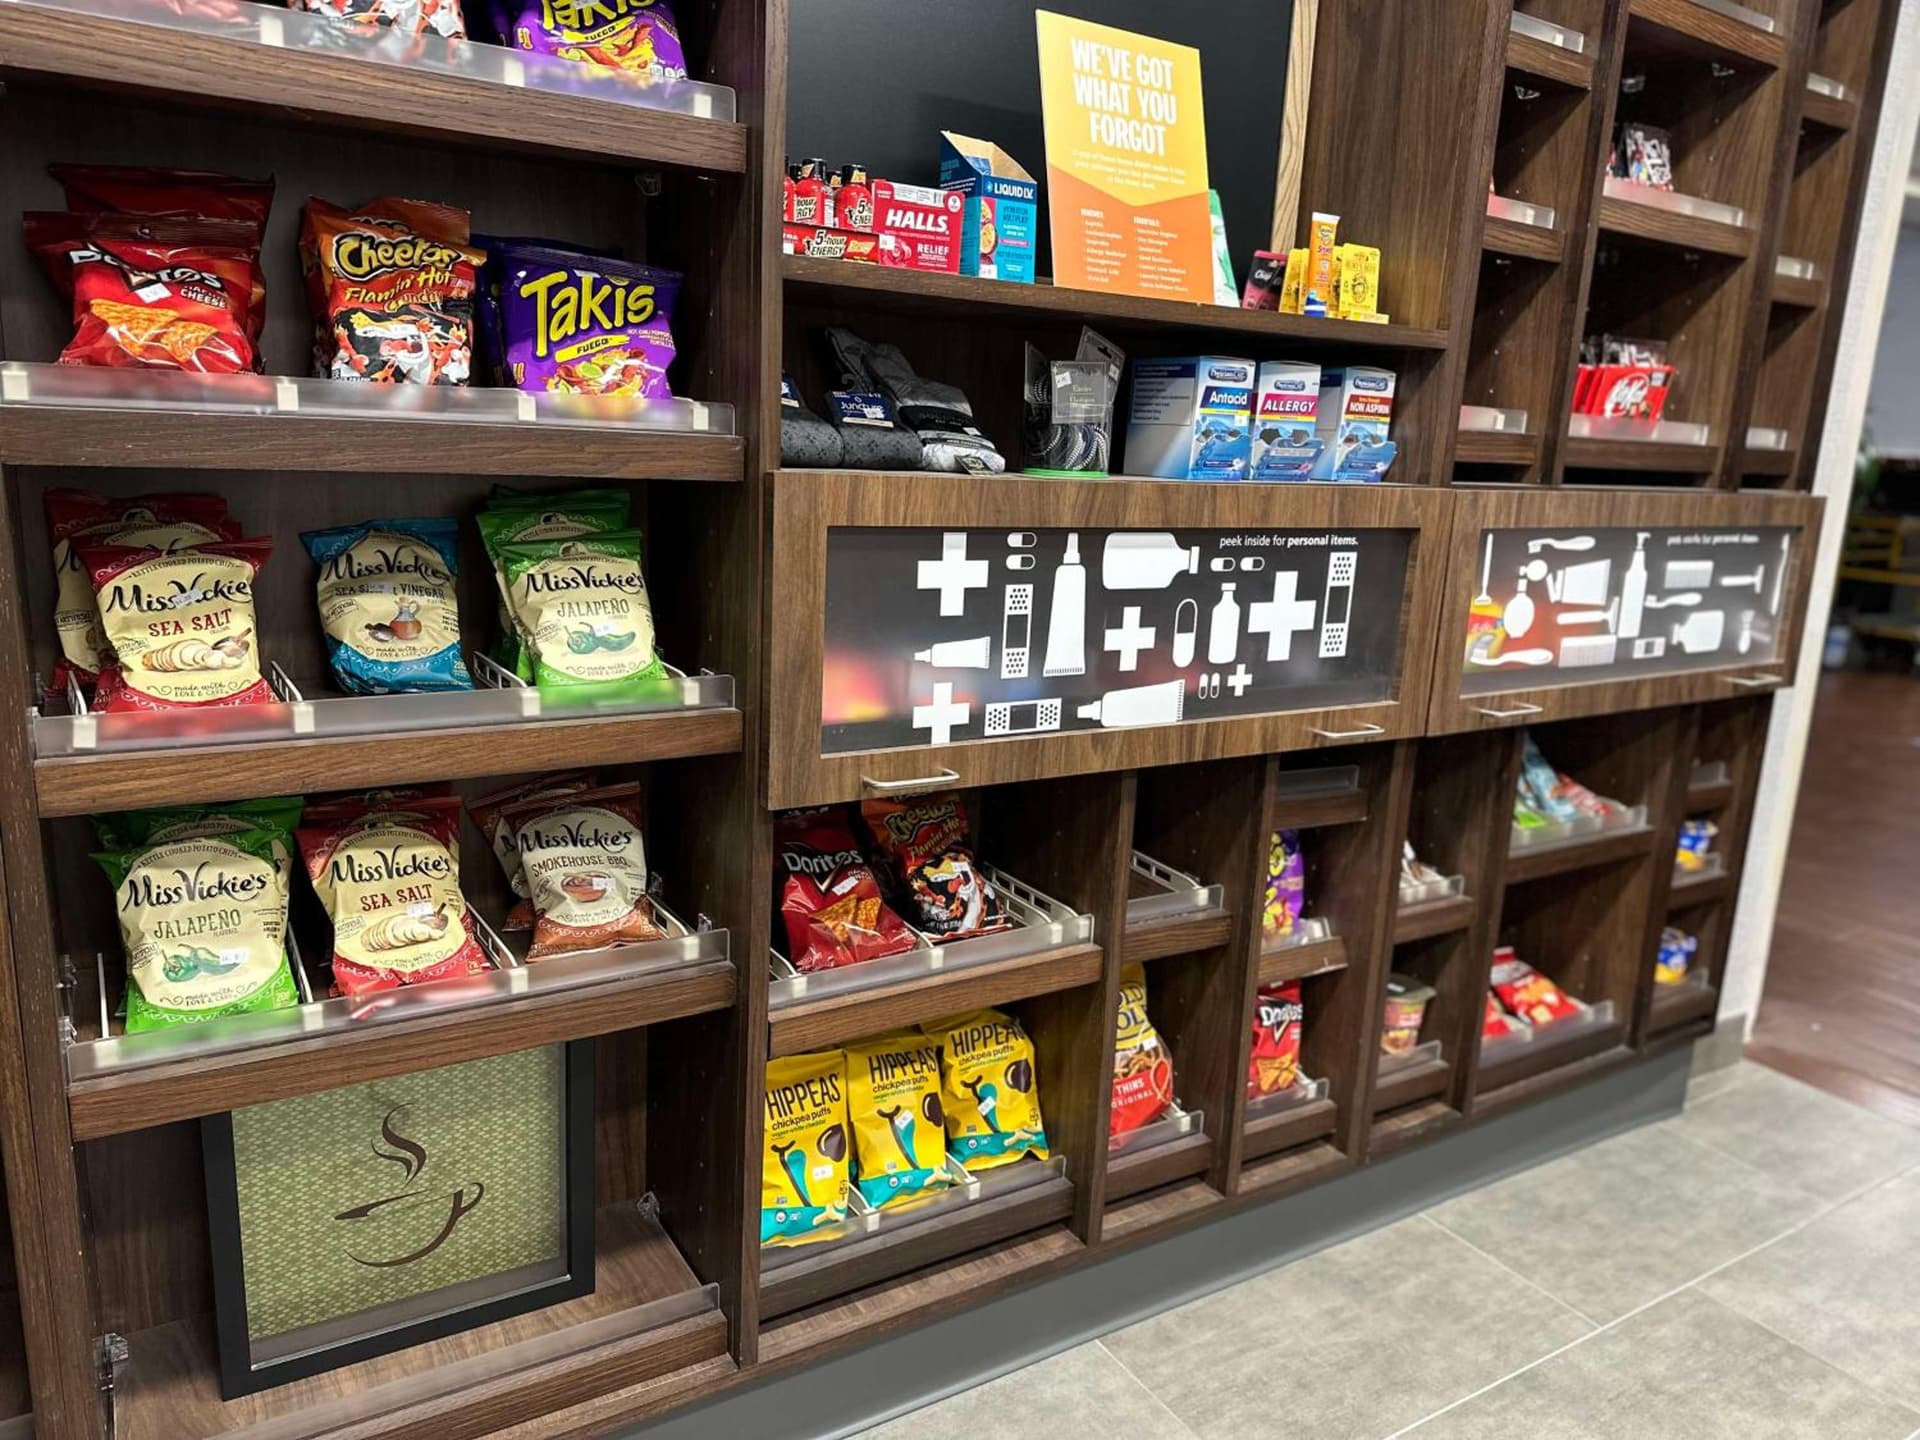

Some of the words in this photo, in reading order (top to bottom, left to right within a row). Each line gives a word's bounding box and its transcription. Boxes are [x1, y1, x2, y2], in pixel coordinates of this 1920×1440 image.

[1071, 38, 1132, 82] WE'VE
[1136, 53, 1173, 91] GOT
[1073, 73, 1131, 116] WHAT
[1137, 87, 1177, 125] YOU
[1090, 111, 1166, 157] FORGOT
[994, 183, 1024, 198] LIQUID
[885, 209, 949, 233] HALLS
[337, 236, 459, 277] Cheetos
[810, 245, 844, 256] ENERGY
[917, 243, 949, 256] RELIEF
[418, 267, 450, 288] Hot
[180, 288, 228, 309] CHEESE
[520, 270, 655, 357] Takis
[577, 338, 609, 354] FUEGO
[1209, 390, 1248, 405] Antacid
[1264, 399, 1315, 413] ALLERGY
[1350, 402, 1366, 412] NON
[1366, 403, 1390, 414] ASPIRIN
[1220, 535, 1242, 549] peek
[1244, 535, 1271, 546] inside
[1272, 534, 1287, 546] for
[1287, 535, 1329, 549] personal
[1330, 534, 1359, 546] items.
[324, 552, 383, 581] Miss
[106, 584, 175, 614] Miss
[168, 573, 253, 607] Vckie
[335, 584, 356, 596] SEA
[400, 583, 446, 599] VINEGAR
[526, 573, 579, 604] Miss
[569, 565, 644, 595] Vickie's
[557, 597, 630, 619] JALAPEÑO
[148, 620, 186, 638] SEA
[192, 608, 233, 632] SALT
[174, 684, 200, 692] made
[520, 830, 569, 854] Miss
[561, 820, 632, 854] Vickie's
[140, 852, 166, 867] KETTLE
[218, 845, 239, 858] CHIPS
[329, 854, 383, 889] Miss
[374, 845, 450, 880] Vickie's
[531, 854, 603, 877] SMOKEHOUSE
[607, 855, 628, 868] BBQ
[782, 849, 864, 873] Doritos
[122, 875, 183, 912] Miss
[172, 861, 267, 902] Vickie's
[360, 893, 393, 912] SEA
[395, 883, 433, 904] SALT
[153, 908, 241, 940] JALAPEÑO
[1260, 1004, 1303, 1027] Doritos
[951, 1022, 1025, 1057] HIPPEAS
[868, 1049, 938, 1083] HIPPEAS
[958, 1050, 993, 1066] chickpea
[993, 1044, 1014, 1057] puffs
[872, 1079, 910, 1093] chickpea
[909, 1075, 929, 1089] puffs
[1115, 1077, 1145, 1095] THINS
[765, 1074, 841, 1120] HIPPEAS
[1112, 1090, 1153, 1109] ORIGINAL
[772, 1112, 811, 1131] chickpea
[810, 1106, 832, 1122] puffs
